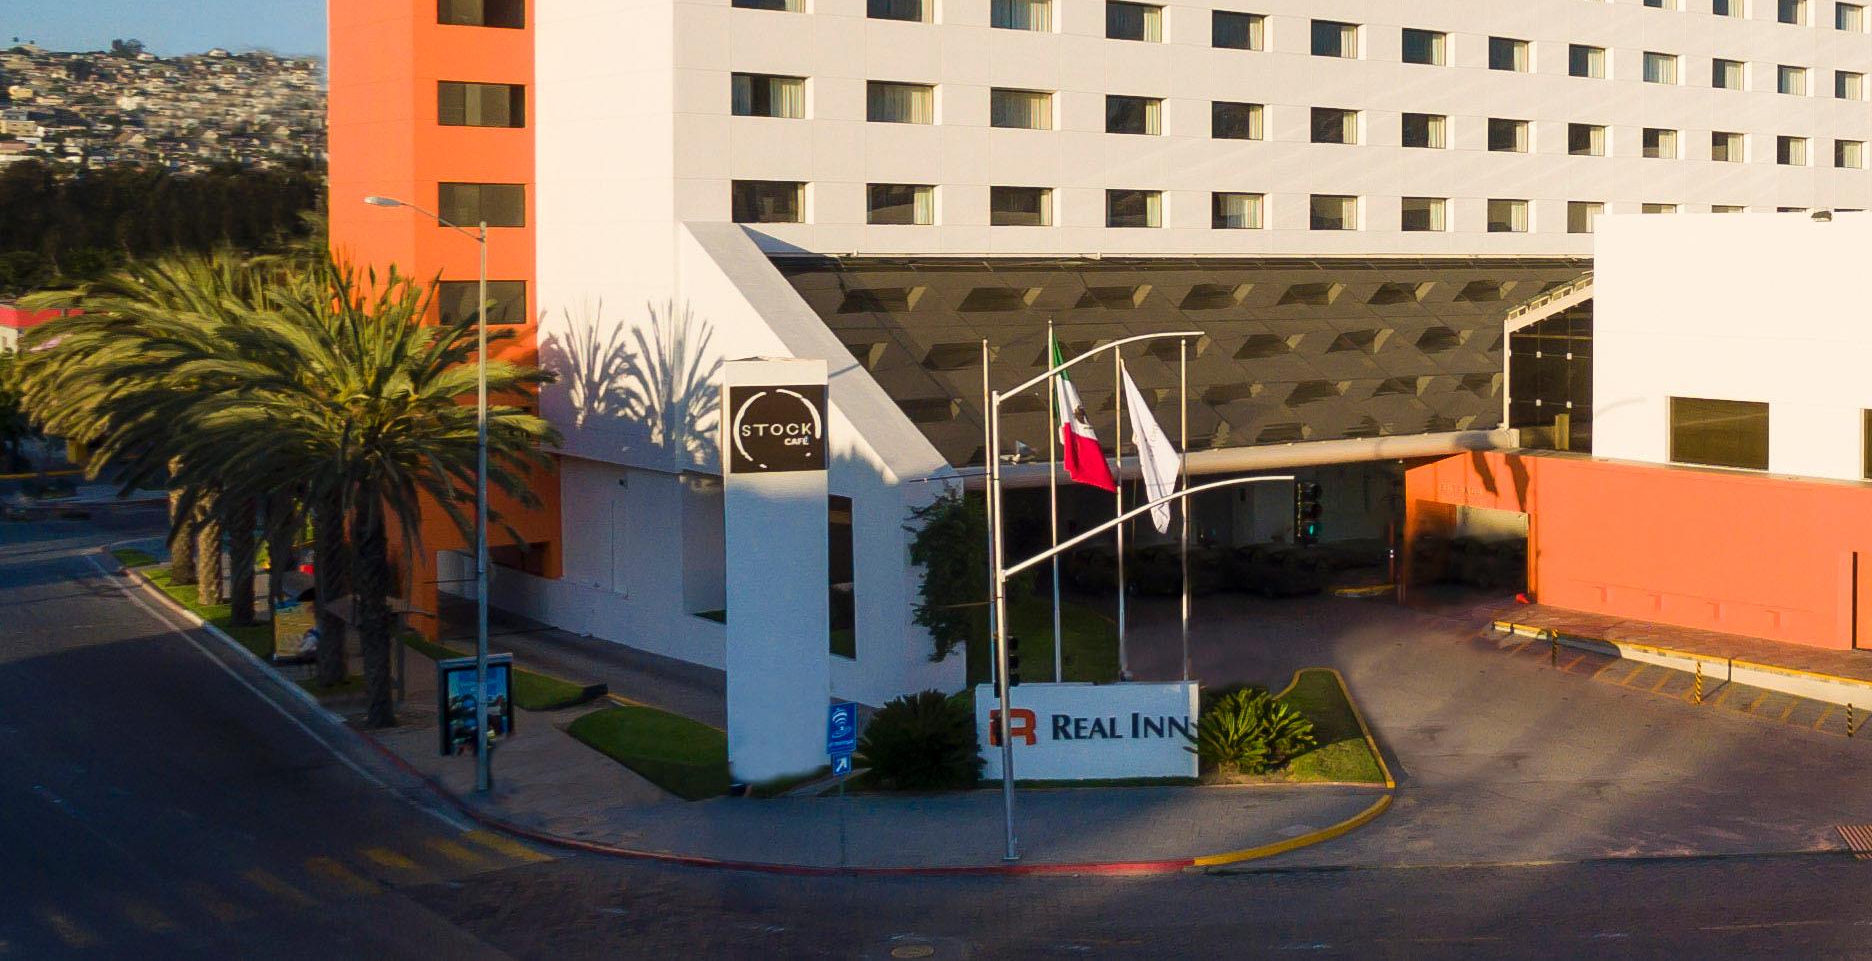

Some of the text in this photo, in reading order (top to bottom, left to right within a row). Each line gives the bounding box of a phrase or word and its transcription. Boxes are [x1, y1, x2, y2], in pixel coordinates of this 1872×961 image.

[741, 423, 812, 436] STOCK
[1051, 712, 1190, 741] REAL INN
